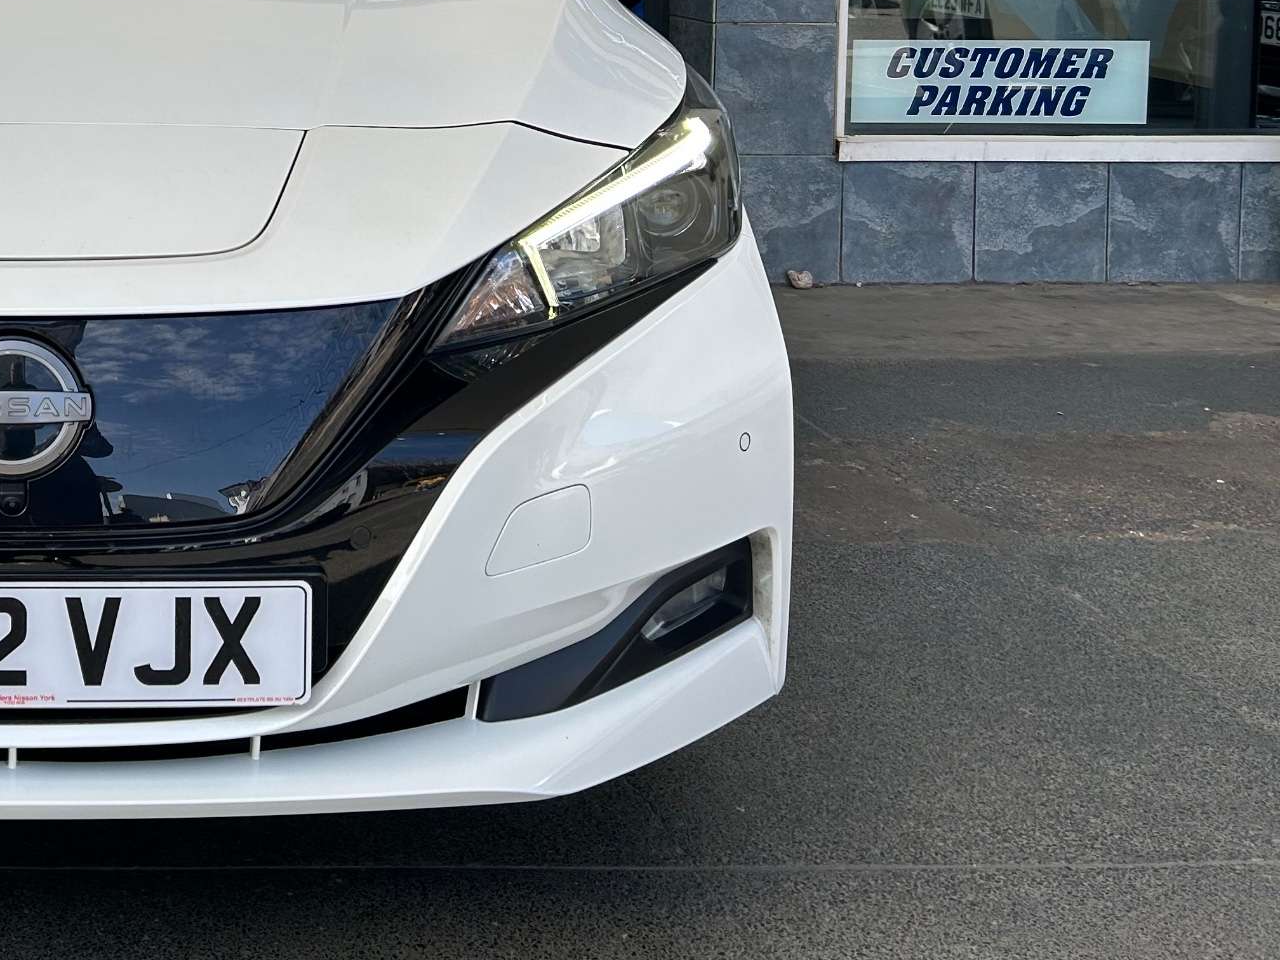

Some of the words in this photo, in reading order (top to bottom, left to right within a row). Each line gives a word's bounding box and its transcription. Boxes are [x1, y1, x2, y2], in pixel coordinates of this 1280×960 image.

[886, 47, 1114, 80] CUSTOMER
[906, 85, 1092, 117] PARKING
[65, 595, 262, 686] VJX
